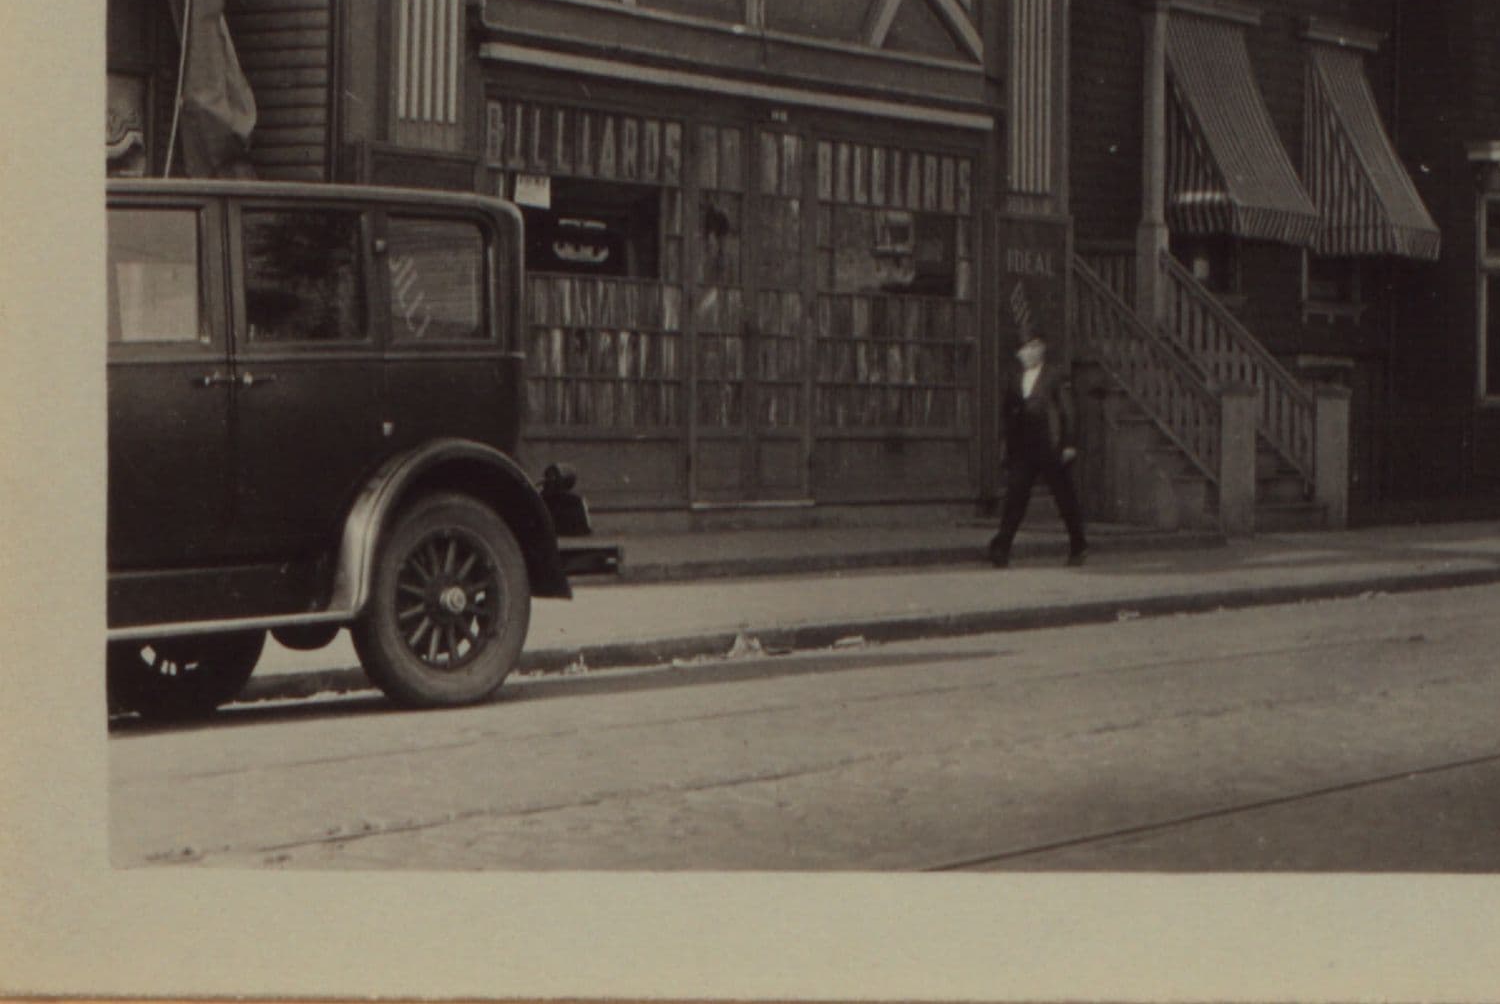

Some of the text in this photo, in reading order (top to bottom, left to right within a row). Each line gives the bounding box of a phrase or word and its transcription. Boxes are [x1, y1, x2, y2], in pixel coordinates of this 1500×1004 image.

[486, 101, 682, 188] BILLIARDS
[816, 140, 971, 216] BILLIARDS
[1007, 248, 1056, 277] IDEAL
